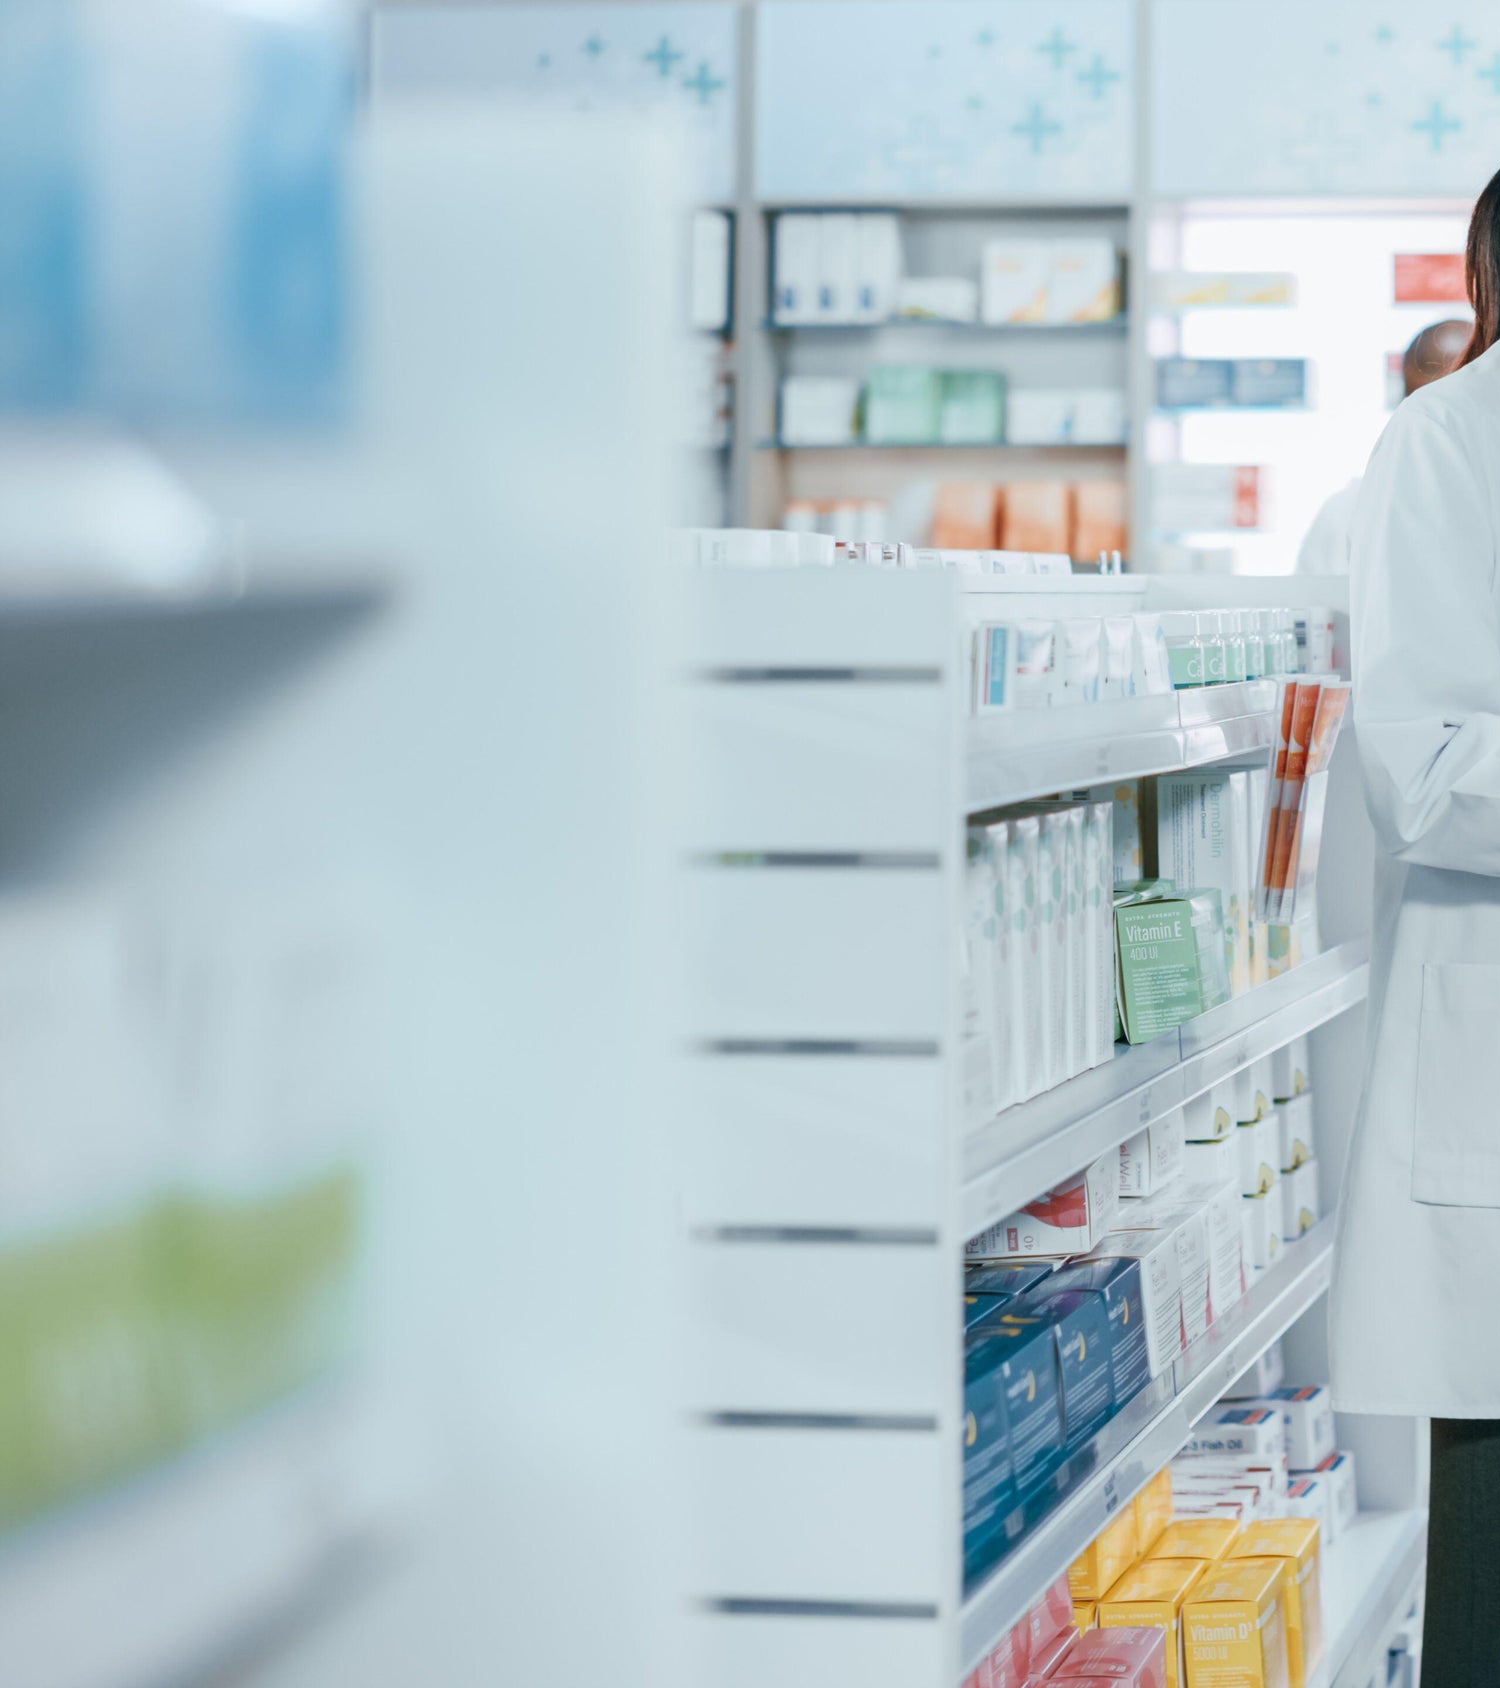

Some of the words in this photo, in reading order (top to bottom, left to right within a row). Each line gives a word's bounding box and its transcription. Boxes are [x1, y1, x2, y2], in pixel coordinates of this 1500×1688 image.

[1125, 921, 1173, 943] Vitamin
[1173, 920, 1183, 938] E
[1130, 947, 1148, 961] 400
[1190, 1624, 1237, 1642] Vitamin
